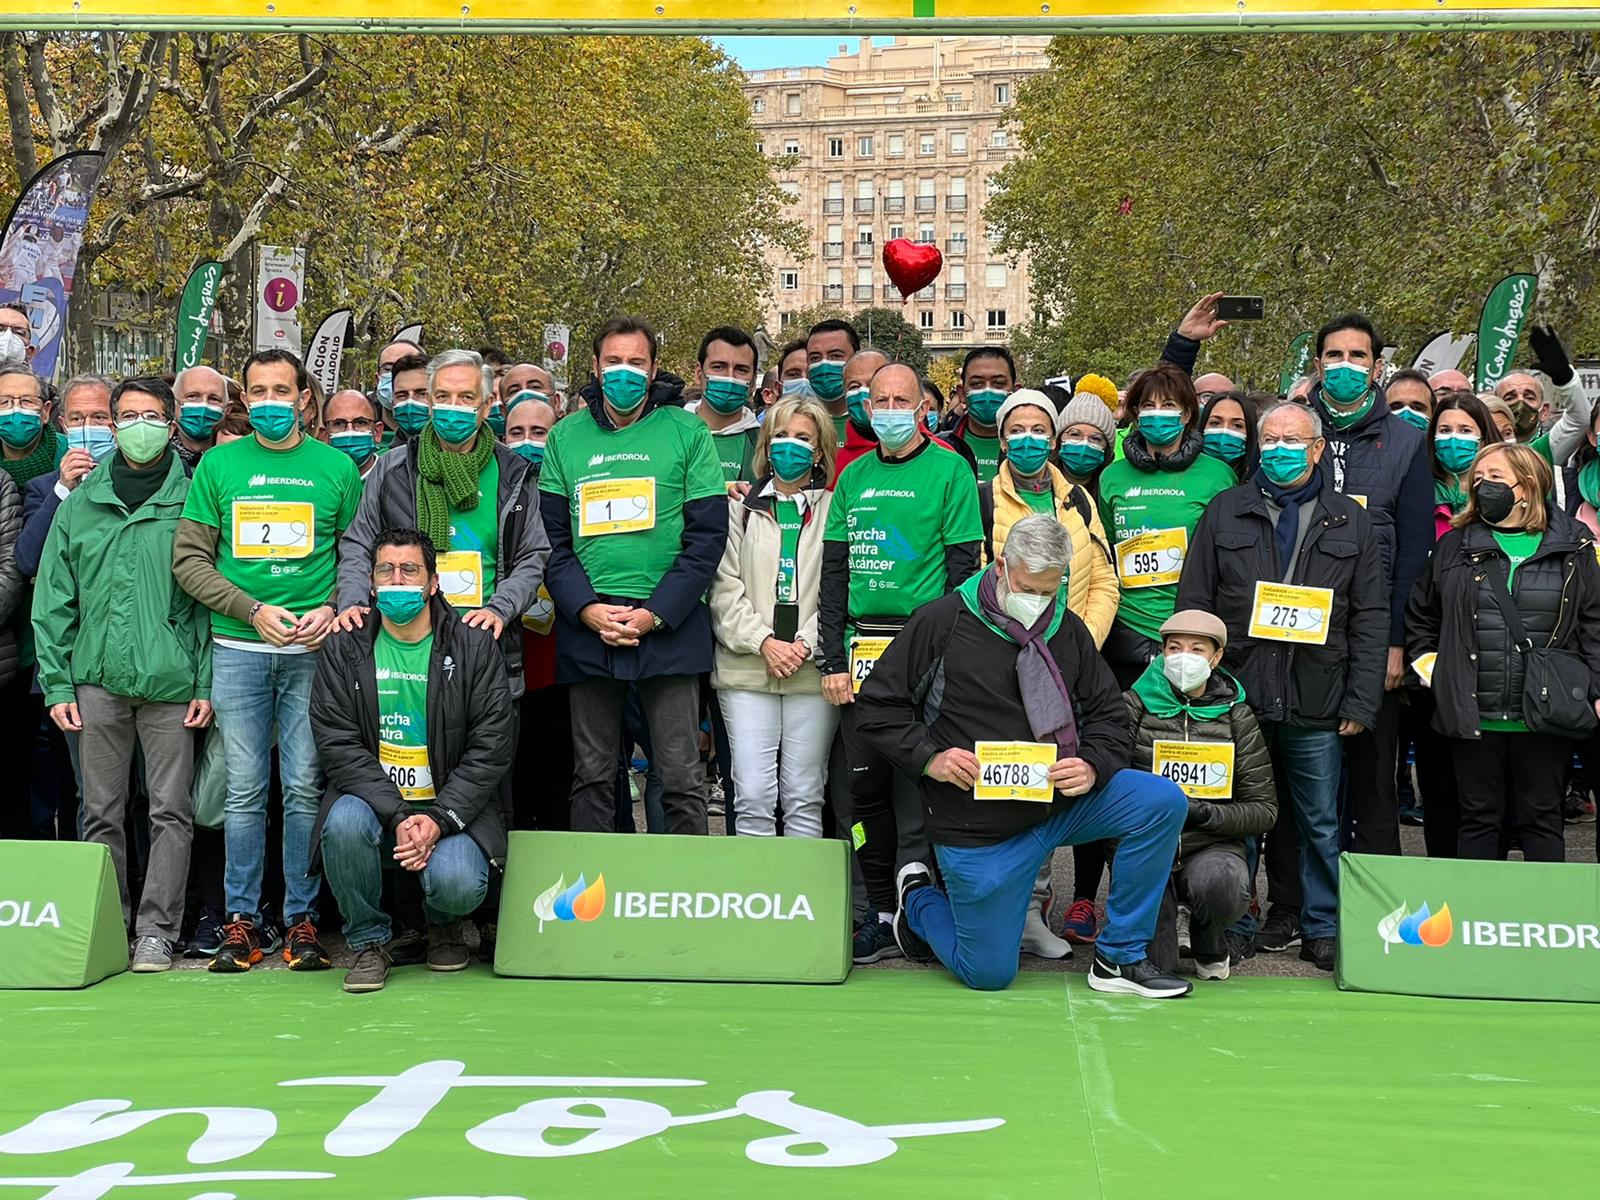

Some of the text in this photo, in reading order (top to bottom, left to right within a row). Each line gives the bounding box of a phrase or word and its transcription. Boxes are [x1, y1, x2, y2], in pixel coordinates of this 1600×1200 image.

[1492, 279, 1528, 338] Inglés
[312, 335, 331, 381] ACIÓN
[326, 336, 340, 393] ALLADOLID
[1486, 338, 1512, 378] Corte
[604, 454, 650, 462] IBERDROLA
[266, 477, 314, 488] IBERDROLA
[874, 489, 915, 498] IBERDROLA
[606, 500, 612, 520] 1
[1114, 513, 1126, 525] En
[847, 514, 857, 528] En
[261, 523, 270, 544] 2
[856, 556, 895, 570] cáncer
[1134, 552, 1159, 574] 595
[1271, 606, 1298, 628] 275
[856, 660, 874, 679] 25
[380, 712, 410, 726] rcha
[380, 729, 403, 740] ntra
[389, 766, 416, 787] 606
[983, 764, 1030, 785] 46788
[1162, 762, 1206, 785] 46941
[613, 891, 816, 922] IBERDROLA
[1462, 920, 1600, 949] IBERDR
